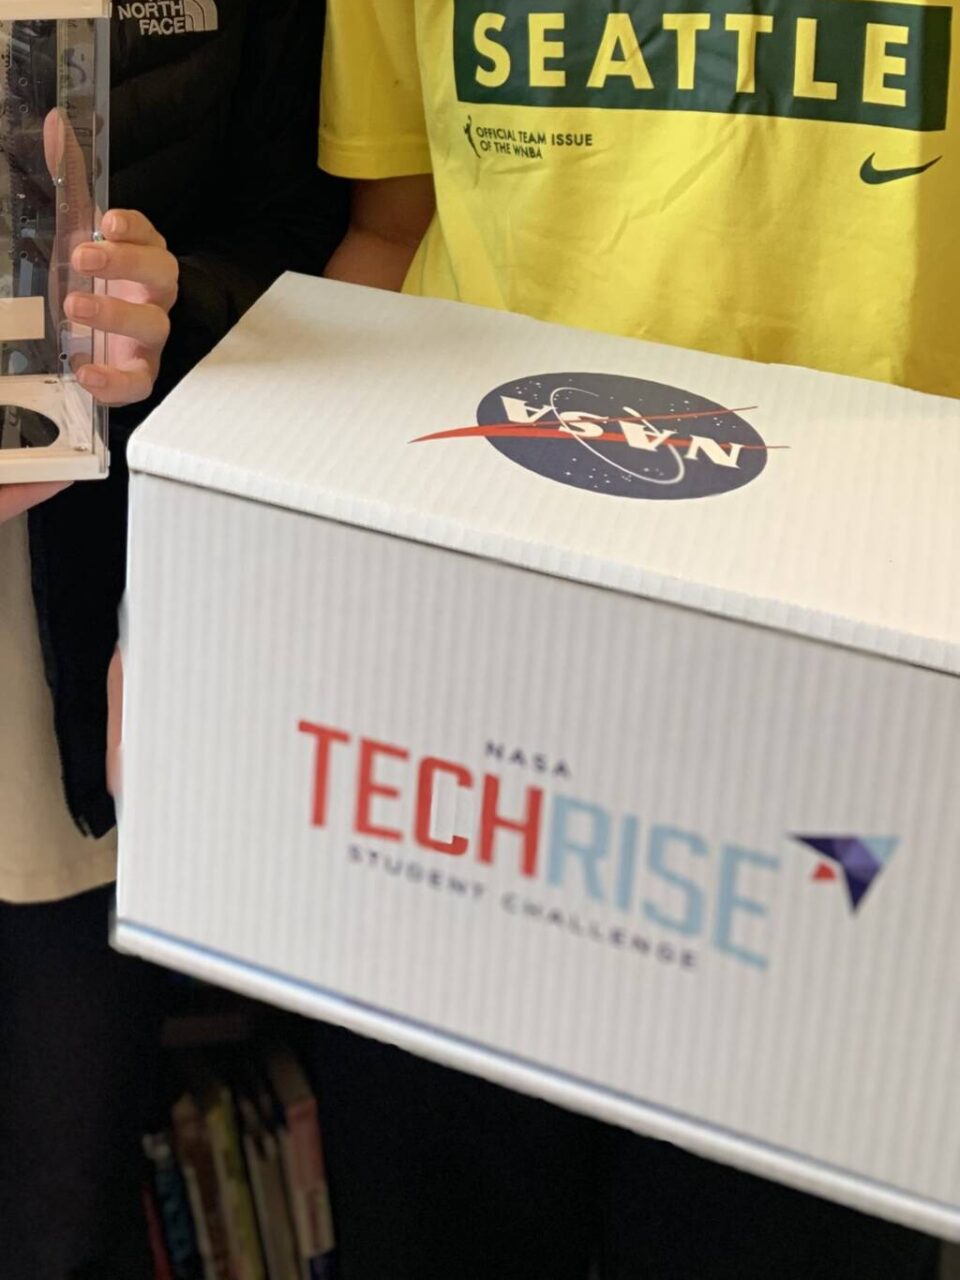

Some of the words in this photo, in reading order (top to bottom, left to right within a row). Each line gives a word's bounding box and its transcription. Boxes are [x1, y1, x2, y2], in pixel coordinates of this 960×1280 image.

[117, 0, 184, 20] NORTH
[140, 17, 185, 35] FACE
[472, 12, 910, 108] SEATTLE
[475, 126, 516, 142] OFFICIAL
[518, 130, 547, 144] TEAM
[551, 133, 593, 146] ISSUE
[480, 140, 491, 151] OF
[493, 141, 511, 155] THE
[512, 144, 543, 159] WNBA
[499, 395, 746, 469] NASA
[484, 740, 572, 779] NASA
[297, 720, 781, 971] TECHRISE
[346, 844, 486, 900] STUDENT
[501, 892, 699, 972] CHALLENGE
